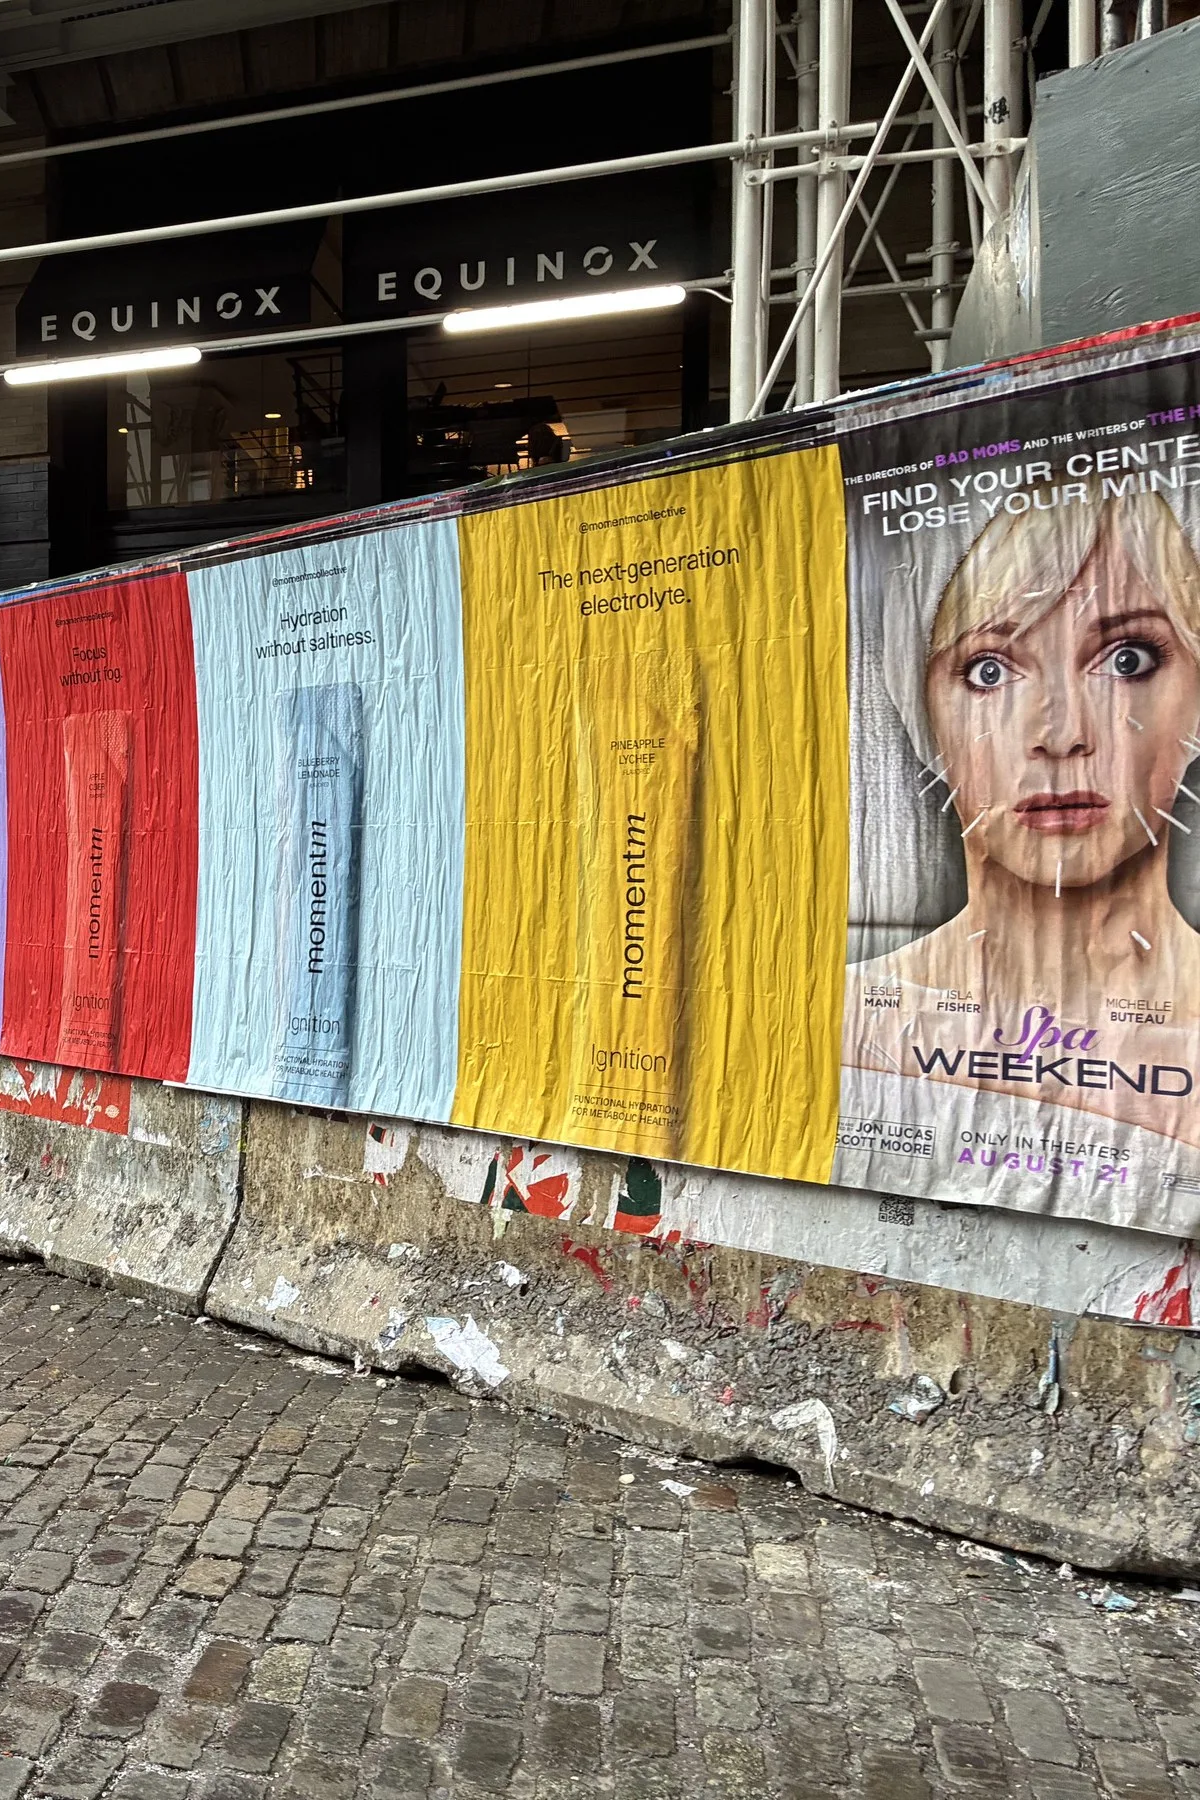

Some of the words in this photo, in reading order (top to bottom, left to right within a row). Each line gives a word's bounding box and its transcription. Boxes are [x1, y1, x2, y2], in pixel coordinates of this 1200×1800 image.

[378, 239, 660, 301] EQUINOX
[40, 286, 285, 343] EQUINOX
[845, 474, 865, 486] THE
[864, 463, 917, 482] DIRECTORS
[919, 460, 934, 470] OF
[934, 450, 968, 468] BAD
[972, 439, 1021, 460] MOMS
[1022, 436, 1049, 451] AND
[1051, 432, 1073, 445] THE
[1075, 422, 1128, 440] WRITERS
[1129, 419, 1146, 431] OF
[1146, 407, 1186, 426] THE
[862, 481, 938, 516] FIND
[949, 461, 1052, 498] YOUR
[882, 502, 971, 537] LOSE
[979, 482, 1088, 518] YOUR
[1101, 463, 1200, 500] MIND
[578, 505, 687, 534] @momentmcollective
[538, 569, 573, 591] The
[579, 546, 740, 586] next-generation
[580, 587, 692, 617] electrolyte.
[280, 605, 348, 633] Hydration
[73, 646, 107, 663] Focus
[256, 638, 307, 660] without
[309, 629, 377, 652] saltiness.
[60, 668, 102, 688] without
[610, 737, 665, 751] PINEAPPLE
[298, 756, 340, 768] BLUEBERRY
[618, 753, 656, 765] LYCHEE
[297, 769, 340, 780] LEMONADE
[88, 783, 106, 791] CDER
[89, 827, 103, 958] momentm
[308, 818, 327, 974] momentm
[622, 811, 647, 999] momentm
[863, 985, 902, 998] LESLIE
[864, 997, 901, 1009] MANN
[946, 988, 974, 1001] ISLA
[72, 993, 110, 1016] Ignition
[936, 1001, 981, 1014] FISHER
[1106, 997, 1173, 1013] MICHELLE
[288, 1012, 340, 1036] Ignition
[1110, 1010, 1166, 1025] BUTEAU
[993, 1005, 1104, 1064] Spa
[274, 1055, 311, 1066] FUNCTONAL
[591, 1043, 667, 1073] Ignition
[912, 1045, 1194, 1098] WEEKEND
[572, 1106, 588, 1117] FOR
[589, 1108, 638, 1123] METABOLIC
[573, 1095, 627, 1109] FUNCTIONAL
[628, 1100, 679, 1115] HYDRATION
[856, 1122, 883, 1136] JON
[887, 1126, 933, 1141] LUCAS
[880, 1138, 932, 1155] MOORE
[960, 1130, 1009, 1147] ONLY
[1015, 1135, 1034, 1150] IN
[1040, 1138, 1131, 1162] THEATERS
[957, 1146, 1085, 1177] AUGUST
[1097, 1163, 1129, 1184] 21
